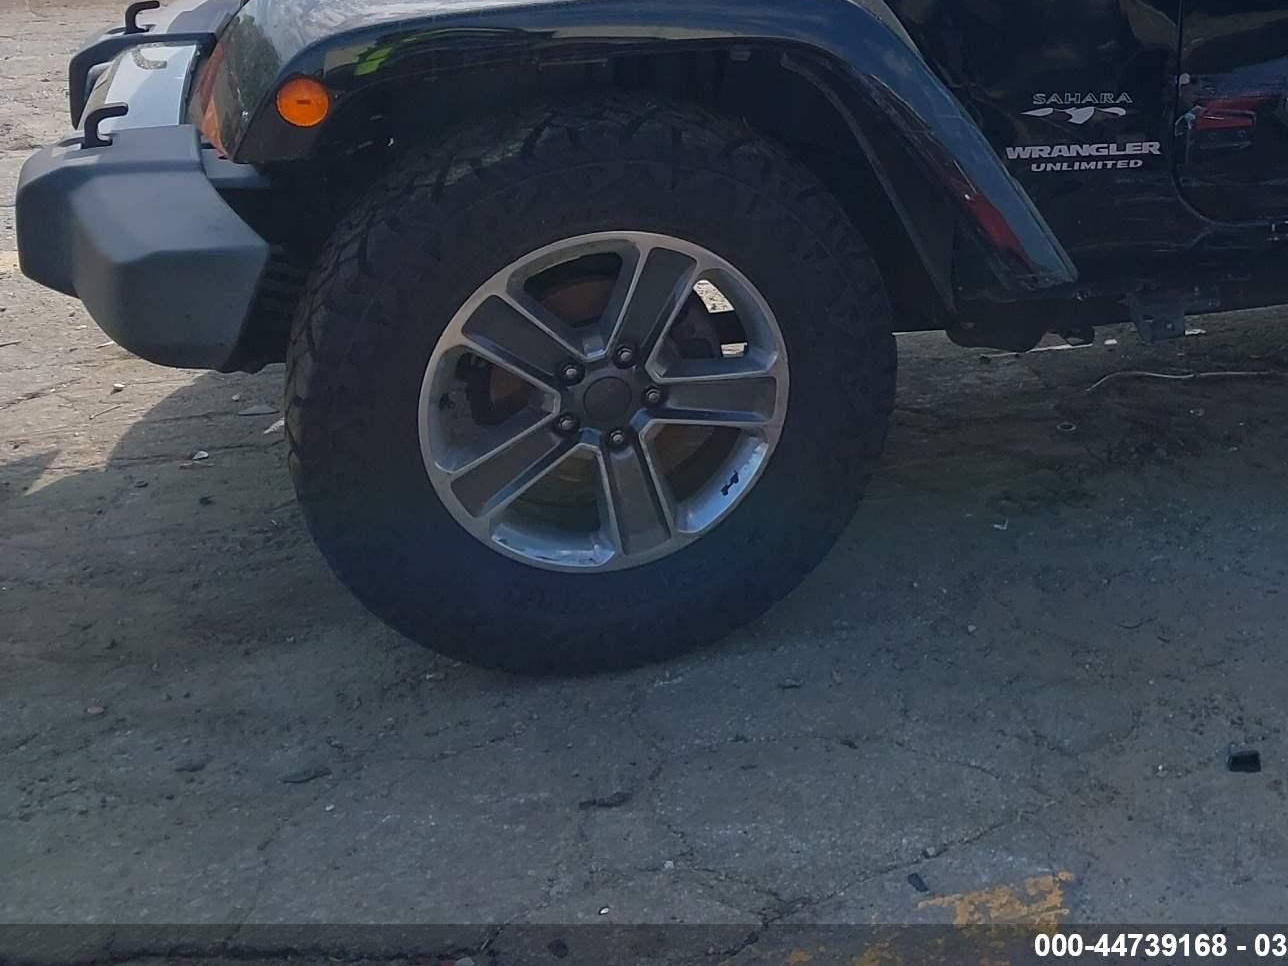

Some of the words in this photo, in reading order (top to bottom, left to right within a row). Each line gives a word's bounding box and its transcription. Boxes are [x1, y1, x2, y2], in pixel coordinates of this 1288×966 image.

[1032, 92, 1133, 105] SAHARA
[1006, 141, 1162, 160] WRANGLER
[1031, 159, 1143, 172] UNLIMITED
